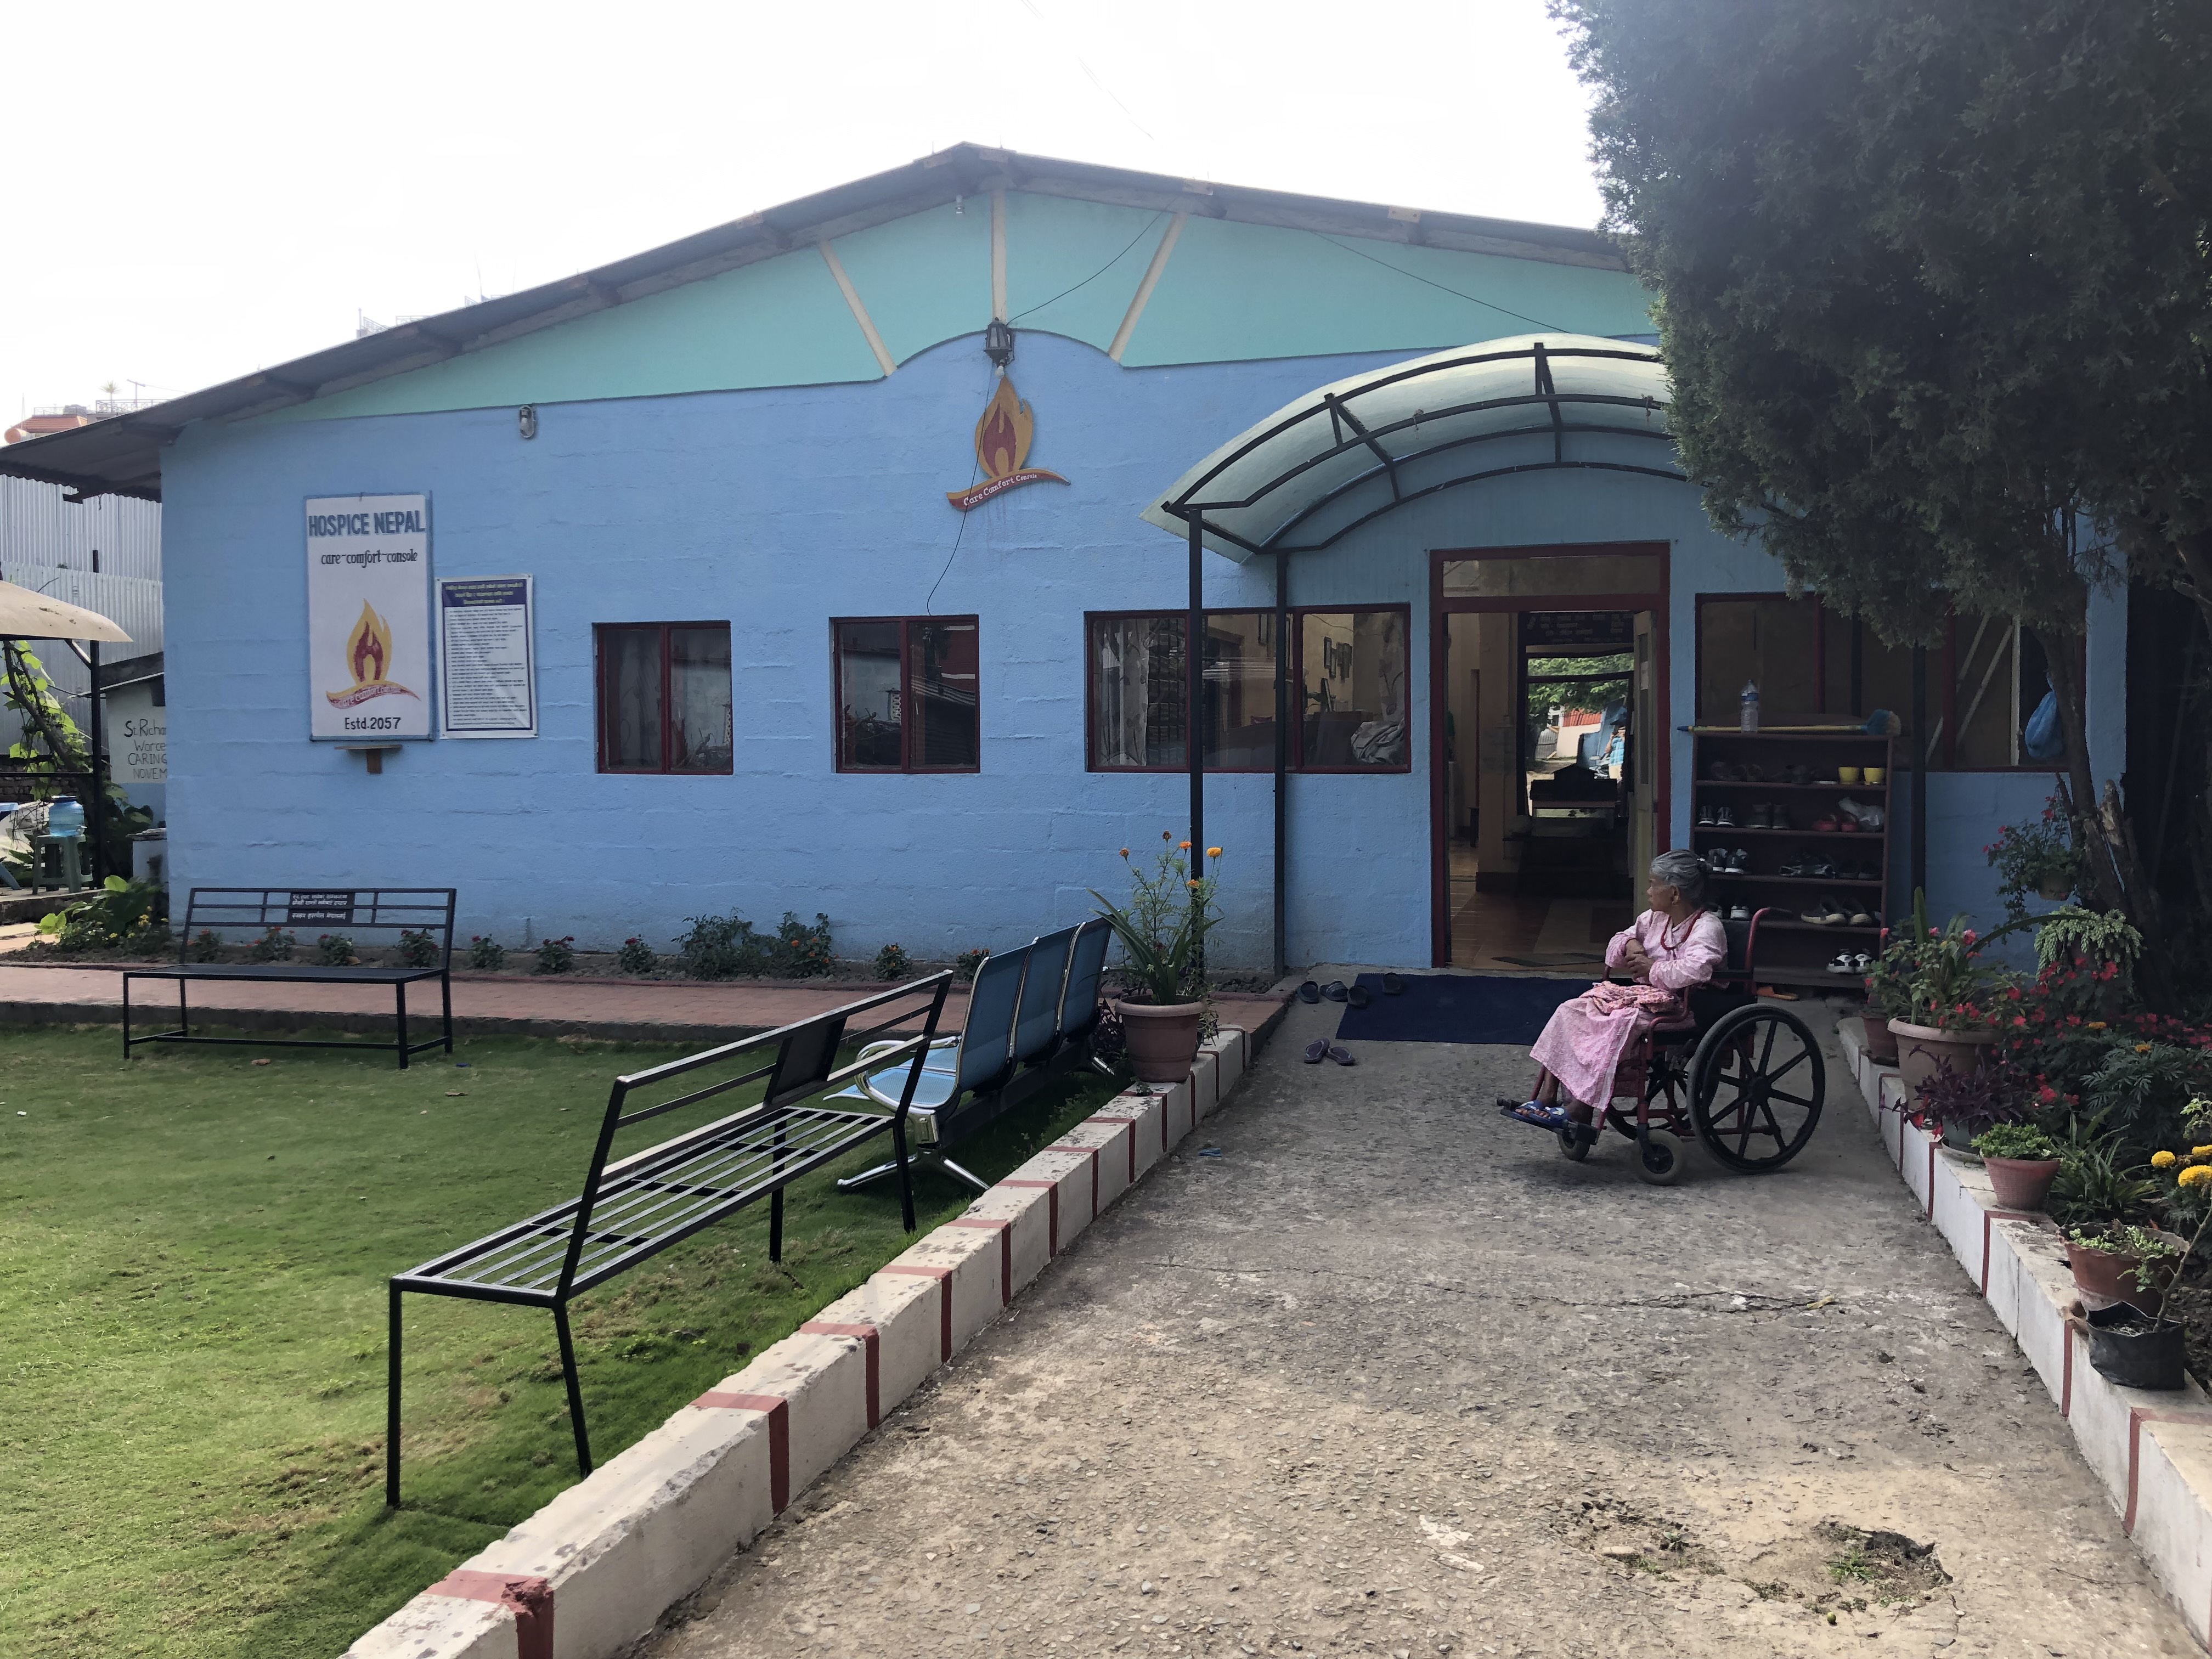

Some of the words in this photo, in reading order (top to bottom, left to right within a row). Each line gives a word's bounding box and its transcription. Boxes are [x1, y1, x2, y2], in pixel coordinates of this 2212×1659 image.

[963, 493, 983, 506] Care
[983, 477, 1015, 496] Comfort
[1015, 473, 1037, 482] Console
[308, 514, 370, 537] HOSPICE
[374, 510, 426, 534] NEPAL
